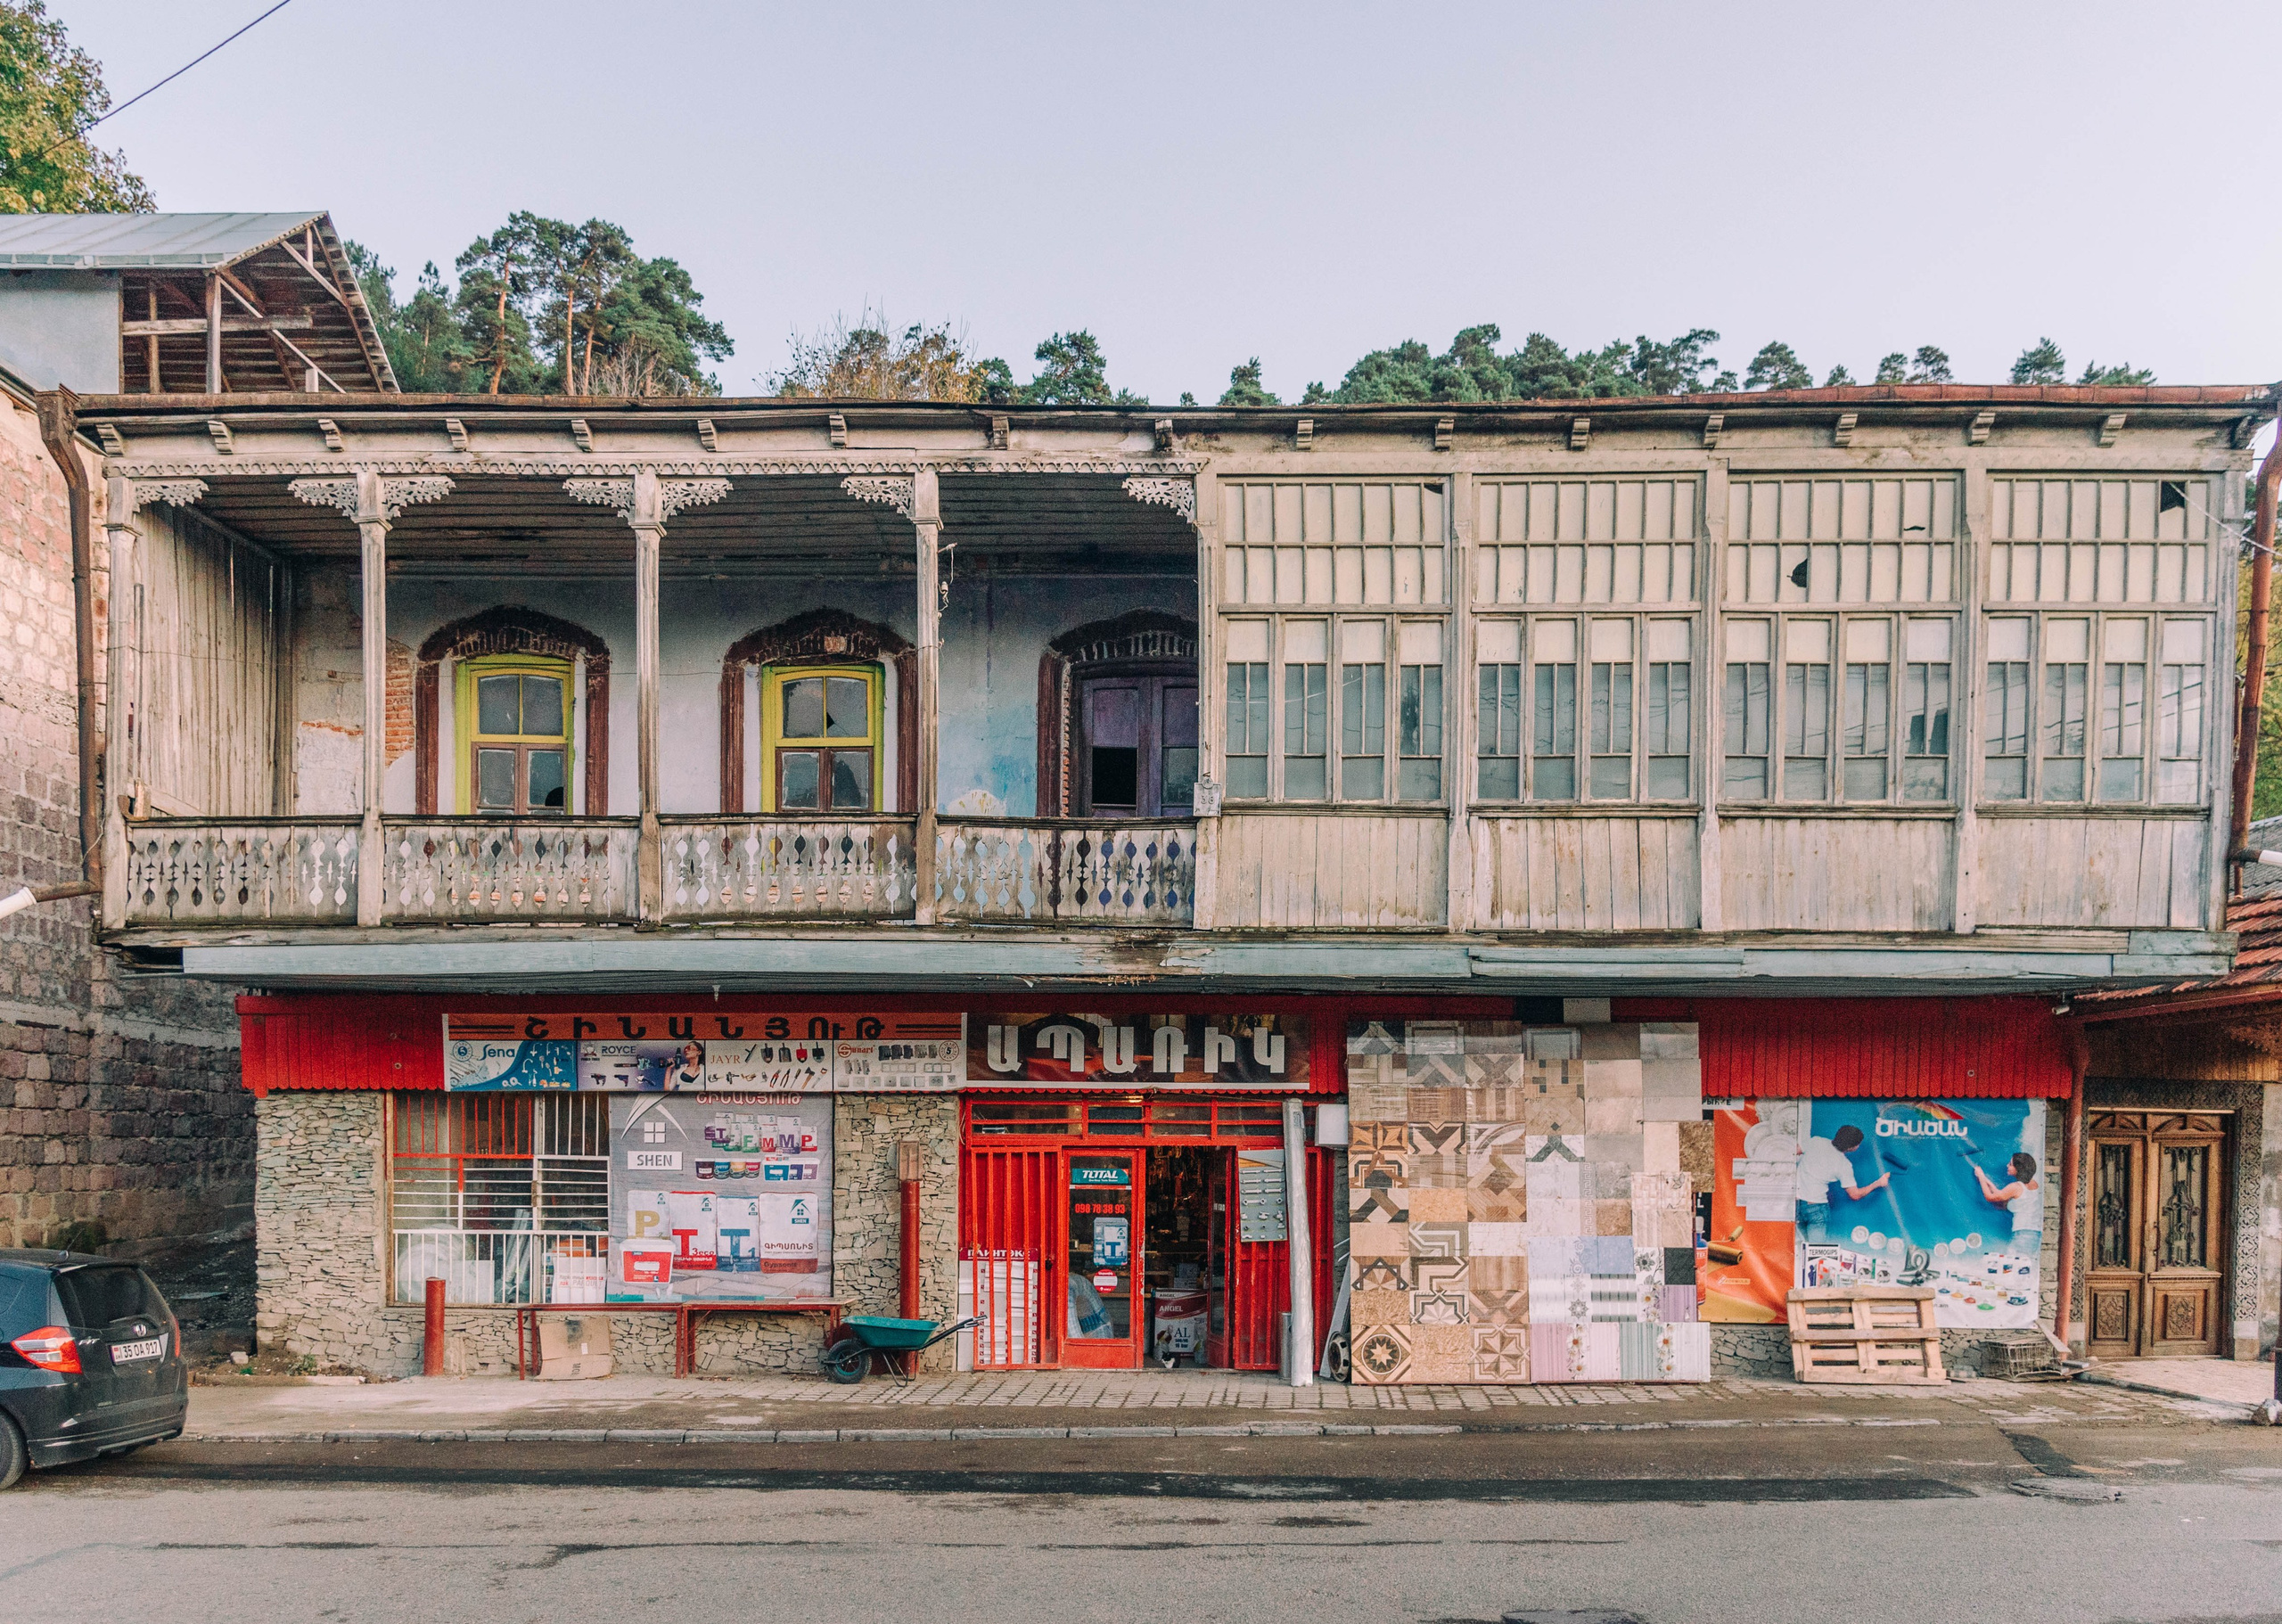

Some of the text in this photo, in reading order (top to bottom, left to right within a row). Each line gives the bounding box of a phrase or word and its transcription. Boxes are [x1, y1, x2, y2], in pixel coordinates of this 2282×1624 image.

[524, 1016, 885, 1040] ՇԻՆԱՆՅՈՒԹ
[477, 1044, 515, 1061] Sena
[601, 1046, 636, 1054] ROYCE
[987, 1024, 1285, 1074] ԱՊԱՌԻԿ
[710, 1054, 741, 1064] JAYR
[636, 1154, 672, 1166] SHEN
[1082, 1170, 1119, 1178] TOTAL
[1075, 1203, 1090, 1214] 098
[672, 1229, 698, 1257] T
[720, 1229, 750, 1258] T
[1105, 1242, 1120, 1257] T
[123, 1345, 133, 1358] 35
[145, 1341, 158, 1355] 917
